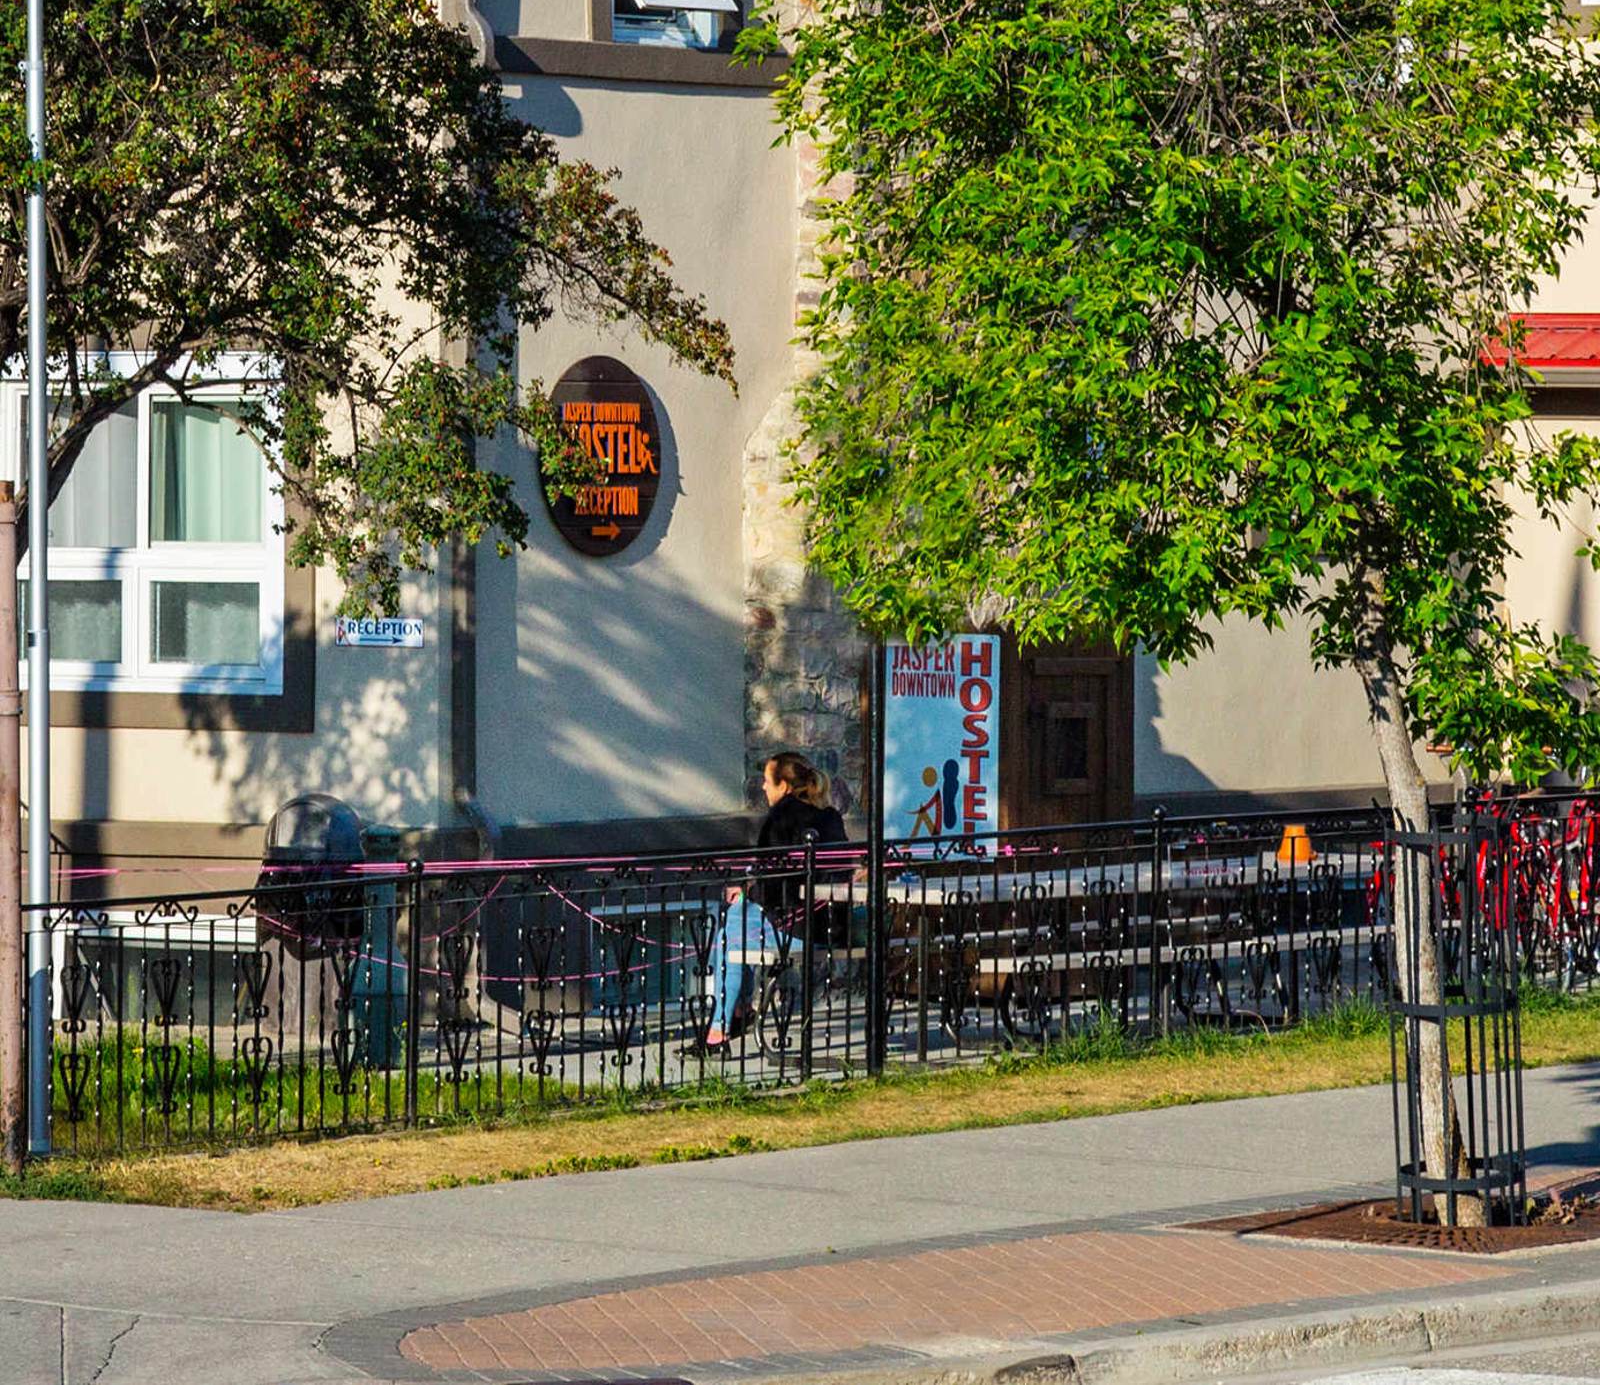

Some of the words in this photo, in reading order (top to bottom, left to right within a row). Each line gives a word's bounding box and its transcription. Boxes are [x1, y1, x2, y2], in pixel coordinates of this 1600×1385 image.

[563, 423, 641, 474] OSTEL
[347, 621, 422, 635] RECEPTION
[892, 672, 955, 698] DOWNTOWN
